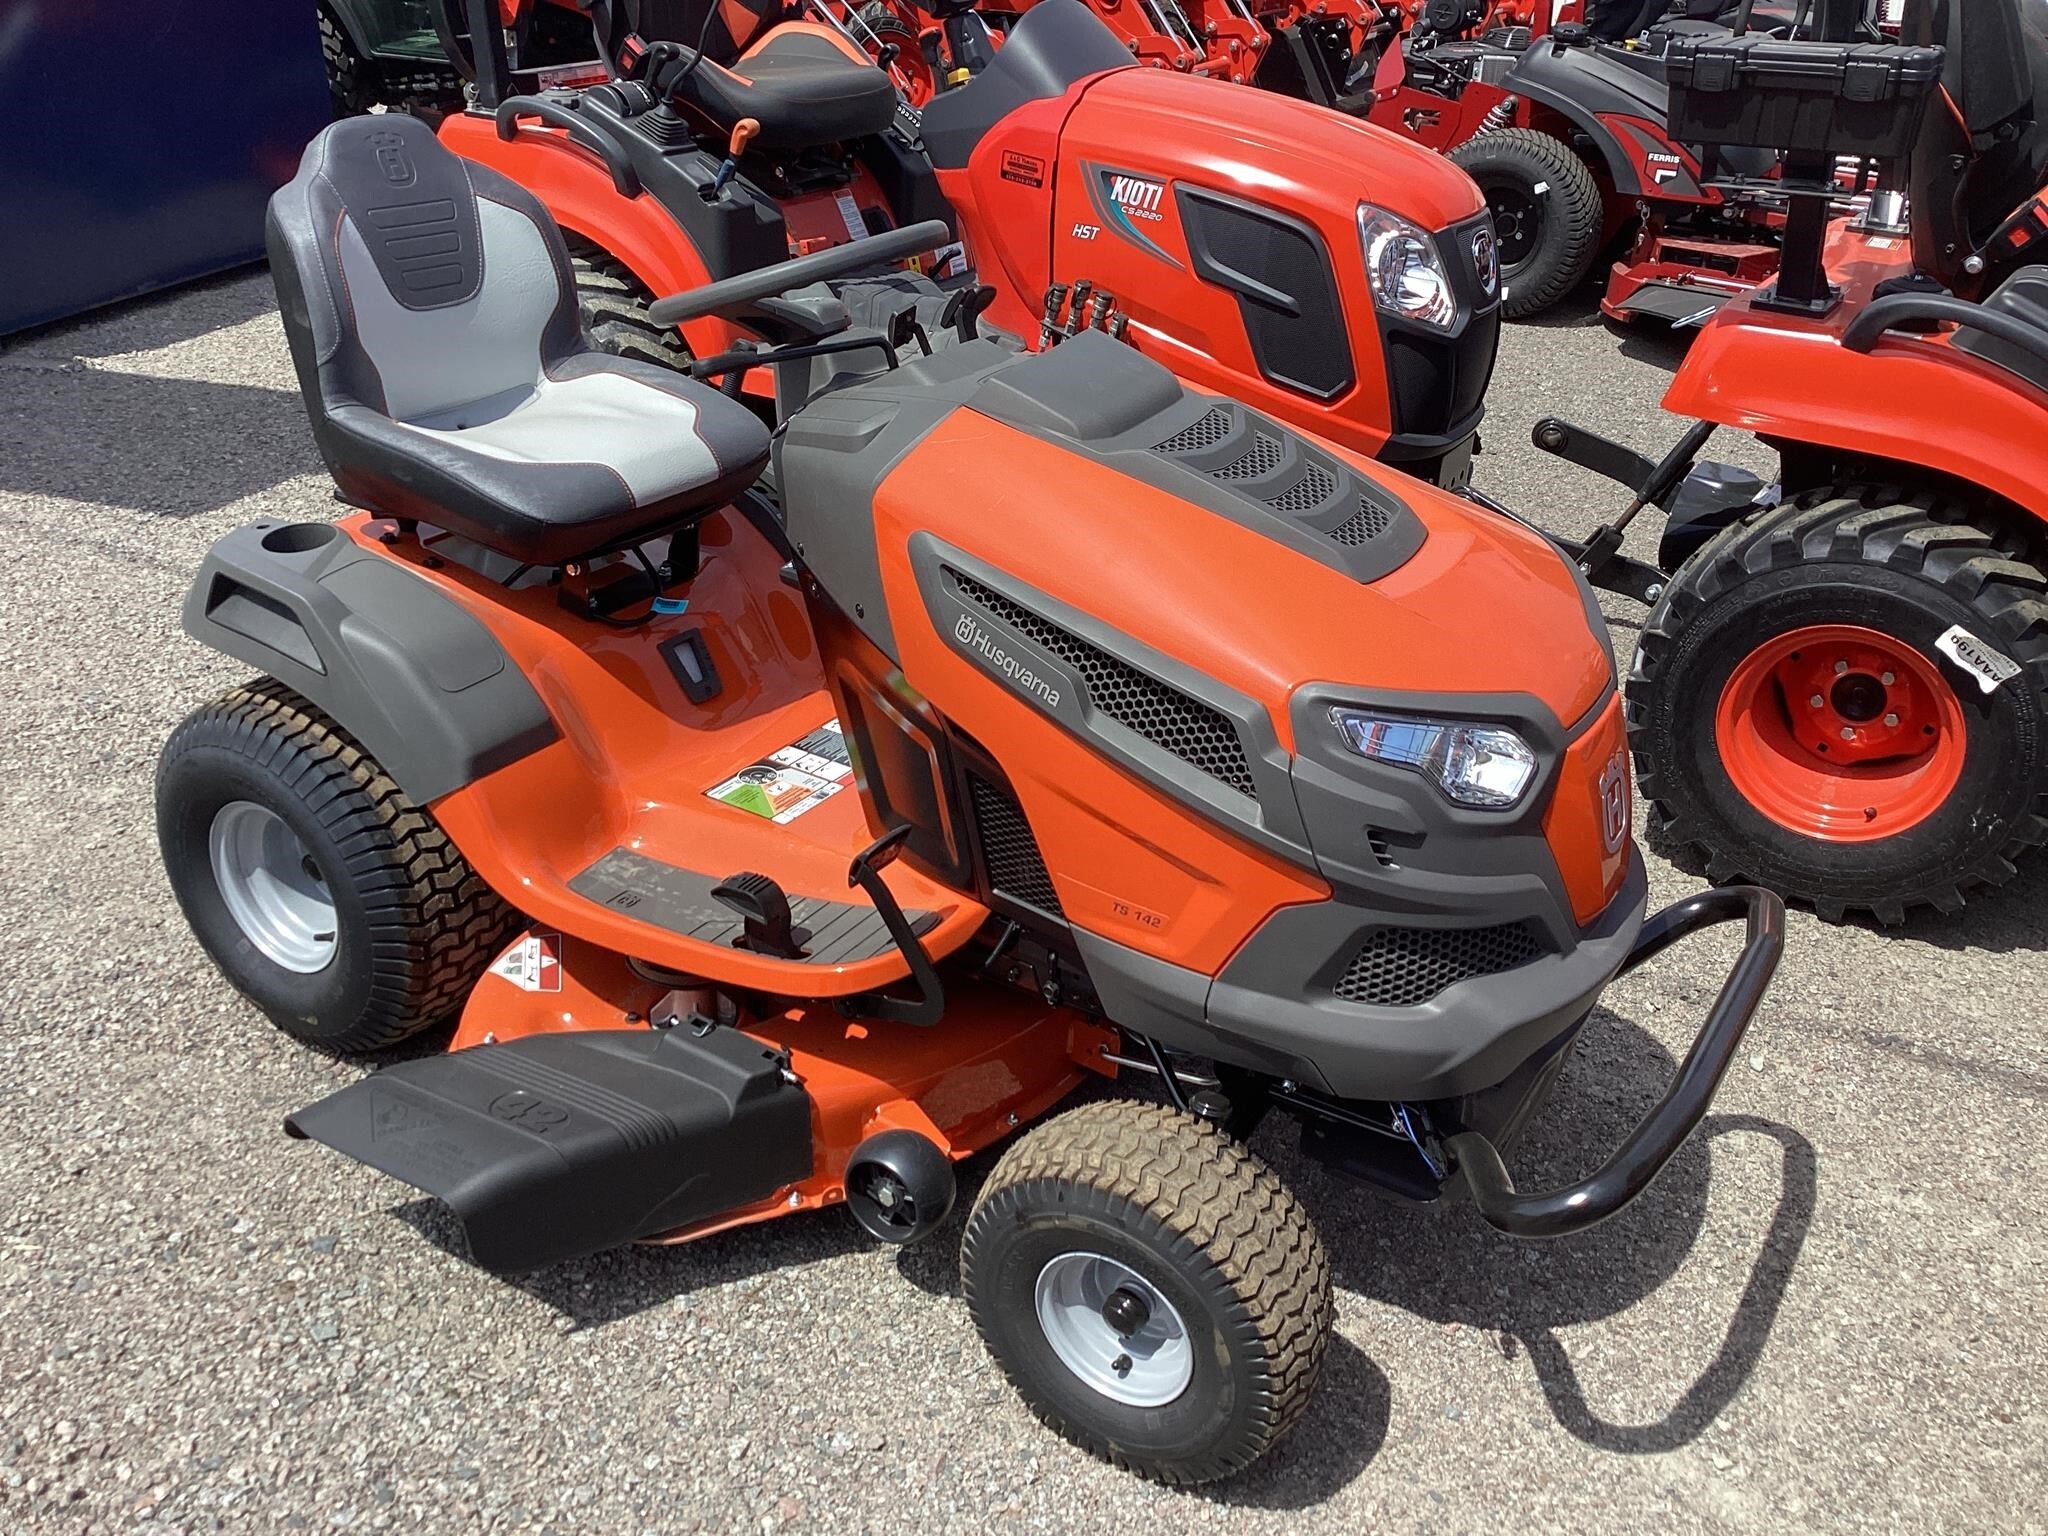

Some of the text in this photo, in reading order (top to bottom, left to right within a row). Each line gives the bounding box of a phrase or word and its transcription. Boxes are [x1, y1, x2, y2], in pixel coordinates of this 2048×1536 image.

[1647, 152, 1680, 164] FERRIS
[1110, 175, 1164, 211] KIOTI
[1121, 205, 1163, 222] CS2220
[1071, 223, 1100, 240] HST
[971, 628, 1061, 708] Husqvarna
[1112, 901, 1161, 928] TS 142
[495, 1098, 569, 1134] 42
